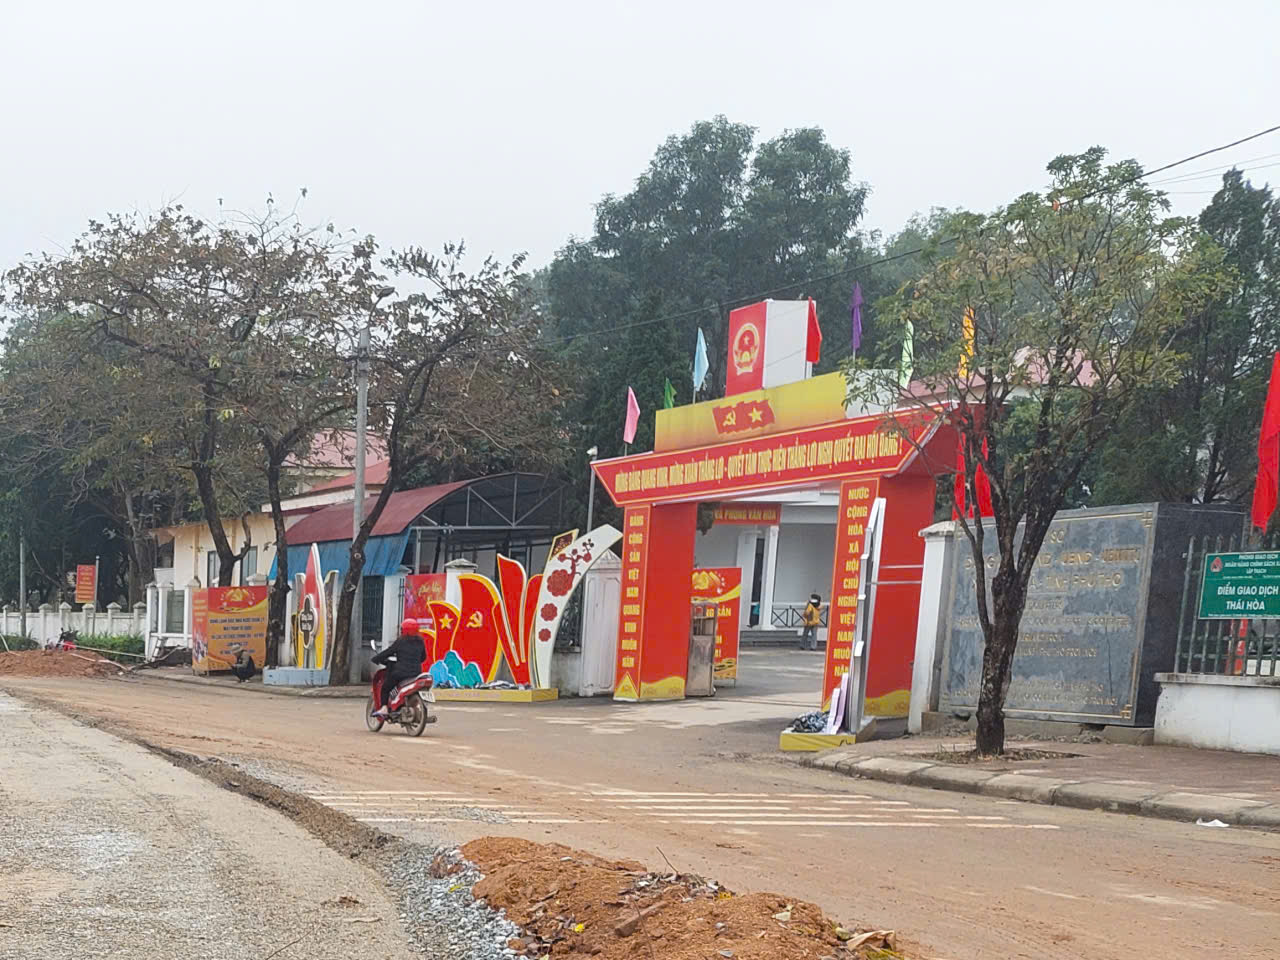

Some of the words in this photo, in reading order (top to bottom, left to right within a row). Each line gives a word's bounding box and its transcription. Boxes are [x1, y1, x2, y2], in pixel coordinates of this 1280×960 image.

[699, 452, 715, 481] THẮNG
[728, 448, 744, 480] QUYẾT
[745, 448, 757, 475] TÂM
[758, 448, 772, 478] THỰC
[772, 443, 786, 476] HIỆN
[787, 437, 806, 469] THẮNG
[807, 441, 817, 471] LỢI
[834, 430, 854, 466] QUYẾT
[854, 435, 866, 465] ĐẠI
[867, 431, 879, 463] HỘI
[848, 487, 869, 500] NƯỚC
[847, 505, 868, 520] CỘNG
[848, 522, 863, 536] HÒA
[843, 575, 859, 589] CHỦ
[1217, 581, 1236, 595] ĐIỂM
[1237, 586, 1257, 595] GIAO
[1259, 585, 1279, 598] DỊCH
[1226, 599, 1245, 610] THÁI
[1247, 598, 1265, 610] HÒA
